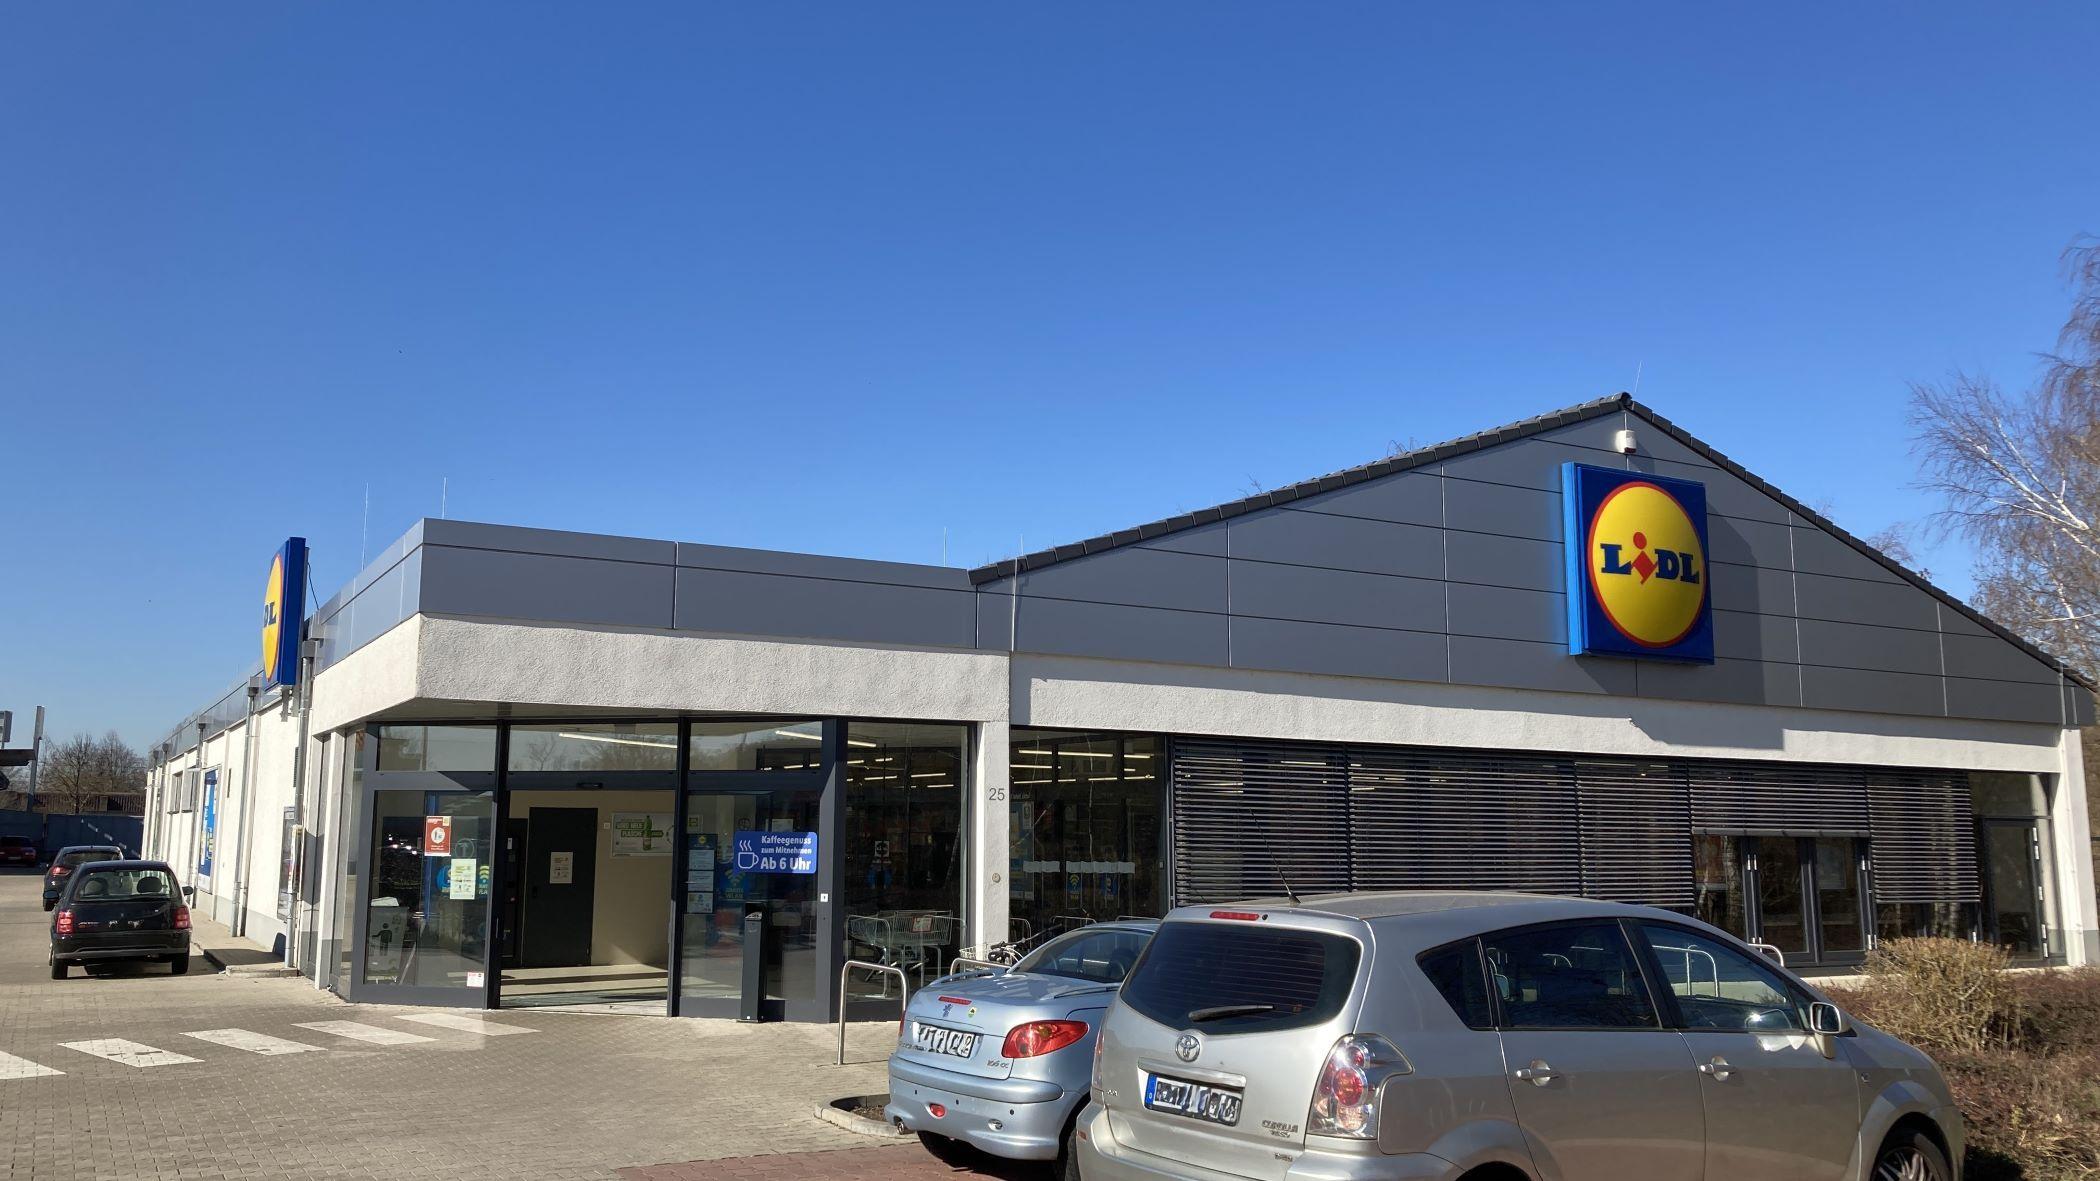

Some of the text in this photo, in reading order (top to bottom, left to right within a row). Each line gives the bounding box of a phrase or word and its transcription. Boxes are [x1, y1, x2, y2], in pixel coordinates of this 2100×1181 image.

[988, 787, 1005, 801] 25
[761, 835, 812, 846] Kaffeegenuss
[775, 846, 812, 854] Mitnehmen
[760, 857, 812, 871] Ab 6 Uhr
